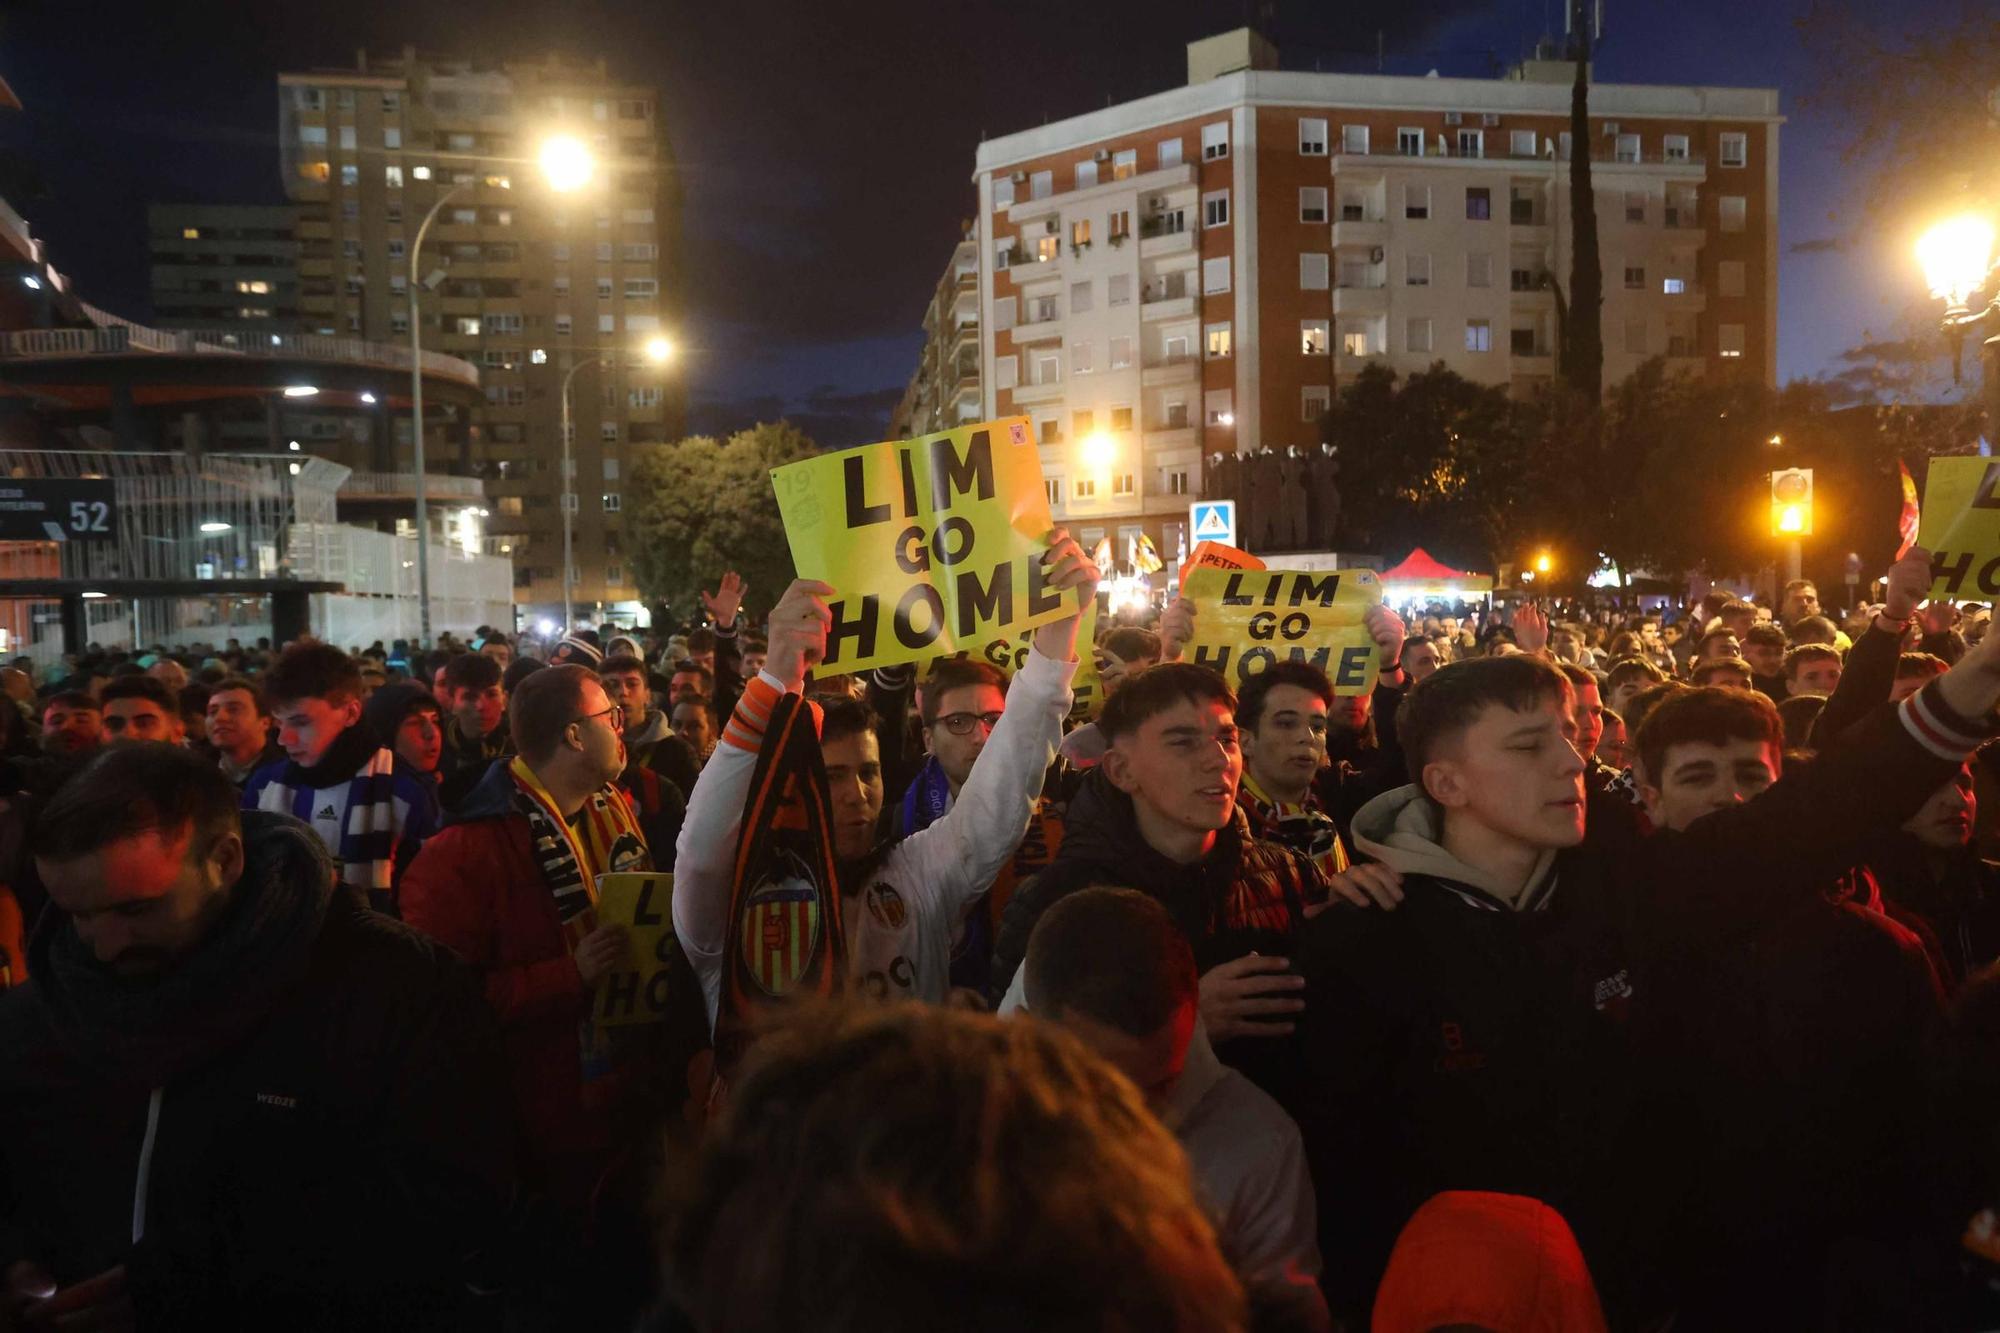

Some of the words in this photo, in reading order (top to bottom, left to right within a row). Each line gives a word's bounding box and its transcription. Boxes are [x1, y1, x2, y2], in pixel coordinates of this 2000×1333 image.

[844, 430, 995, 528] LIM
[70, 501, 109, 532] 52
[895, 516, 975, 575] GO
[821, 552, 1061, 667] HOME
[1222, 573, 1340, 608] LIM
[1248, 611, 1311, 641] GO
